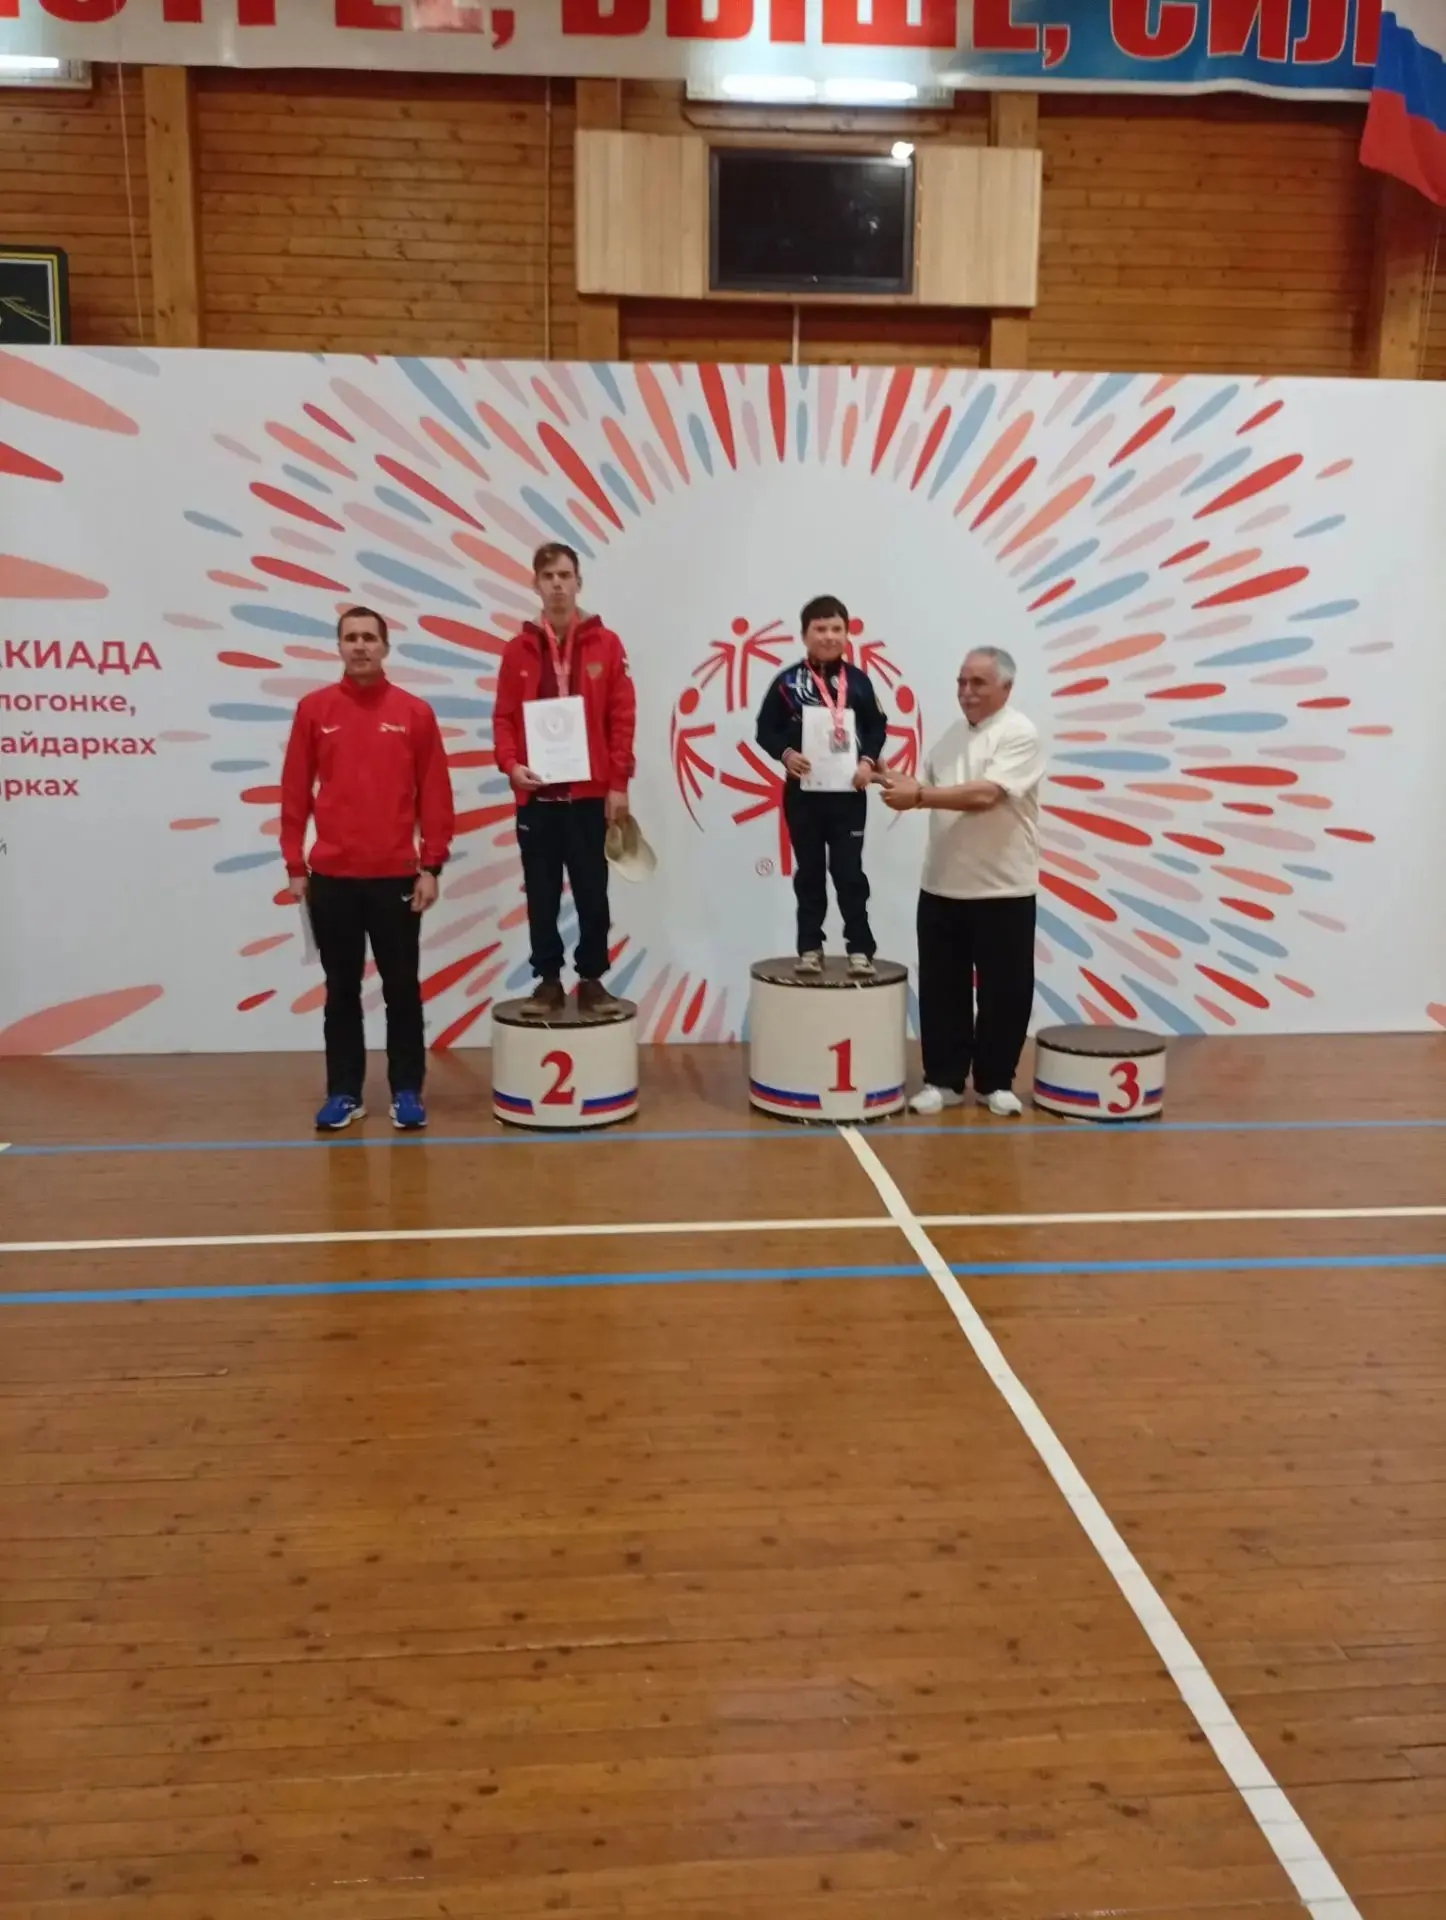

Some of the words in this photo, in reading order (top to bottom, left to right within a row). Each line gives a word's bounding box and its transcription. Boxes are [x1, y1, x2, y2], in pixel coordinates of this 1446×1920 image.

[0, 639, 163, 675] КИАДА
[0, 778, 79, 801] рках
[540, 1050, 575, 1105] 2
[828, 1038, 857, 1092] 1
[1108, 1061, 1141, 1113] 3
